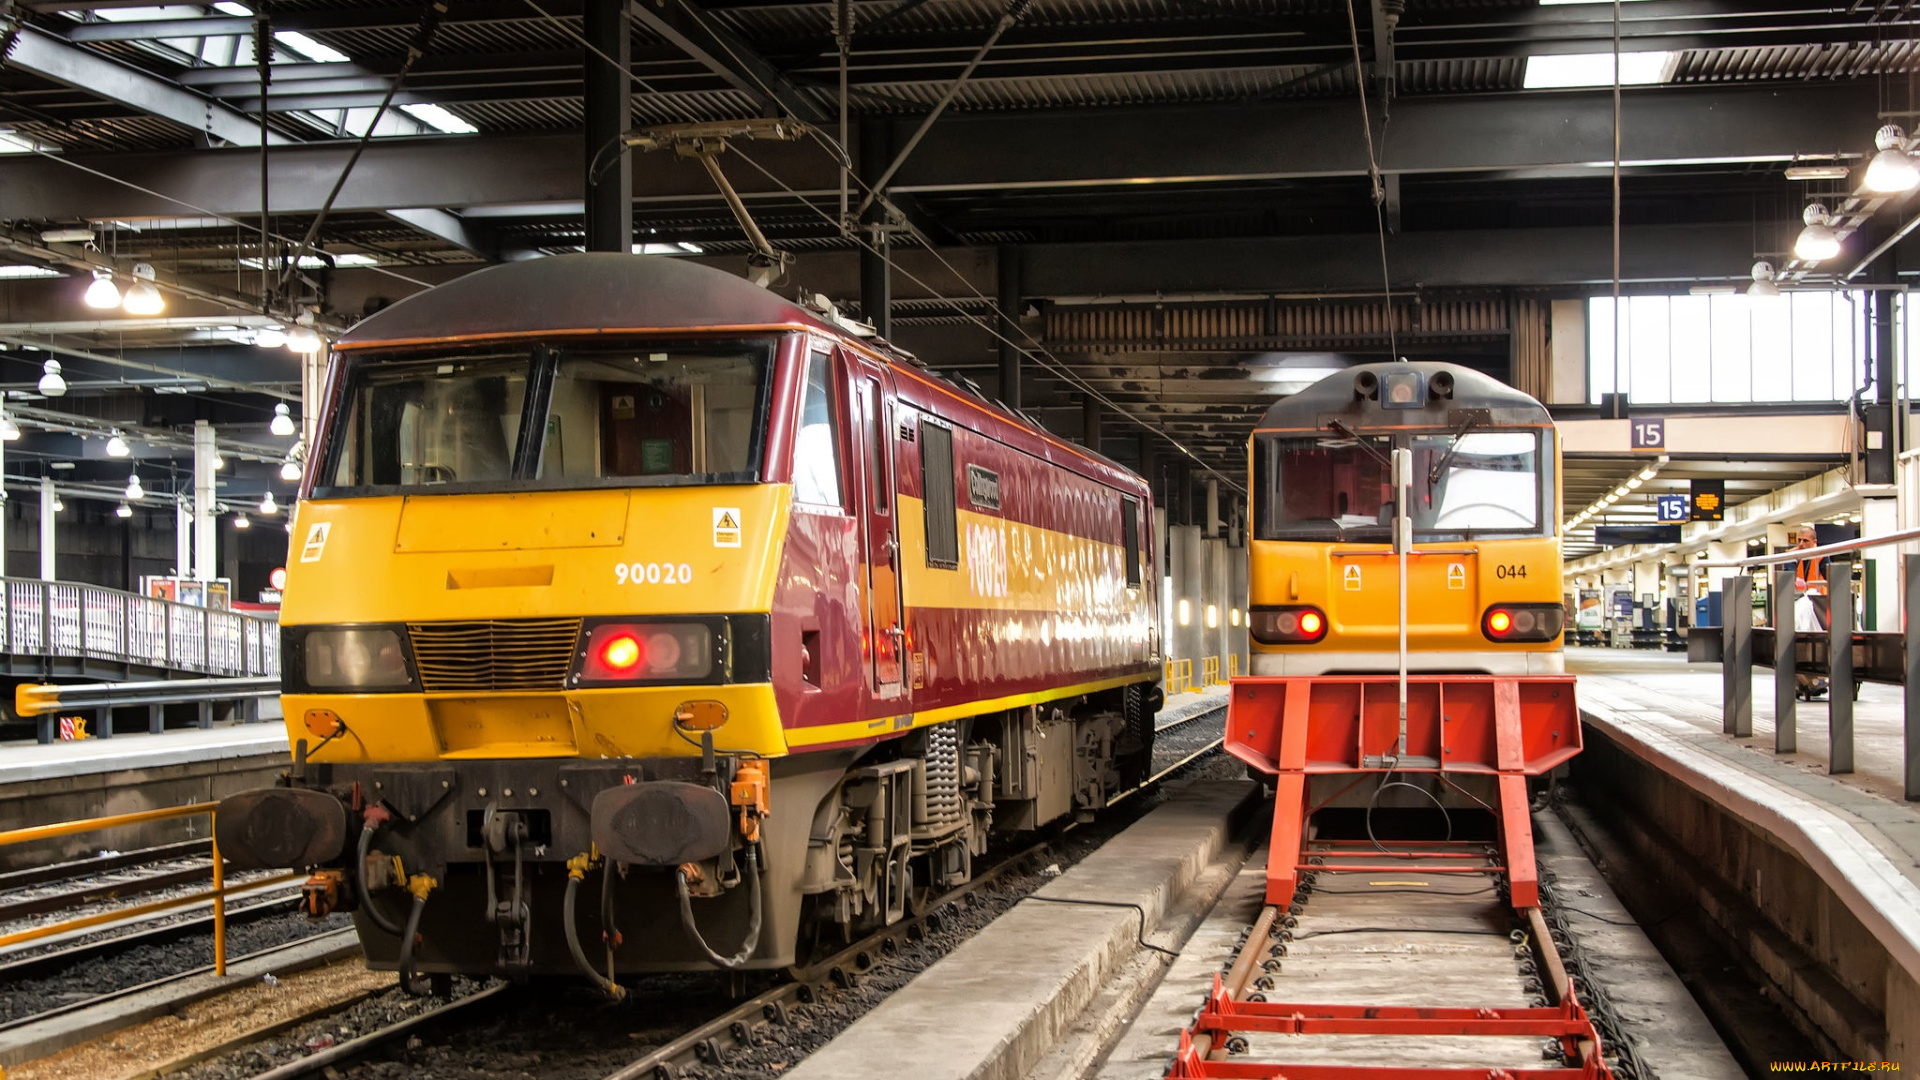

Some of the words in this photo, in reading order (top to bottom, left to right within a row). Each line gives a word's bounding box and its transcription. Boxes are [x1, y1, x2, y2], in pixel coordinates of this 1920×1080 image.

[1635, 424, 1661, 446] 15
[1660, 500, 1683, 519] 15
[614, 562, 692, 585] 90020
[1496, 564, 1527, 579] 044
